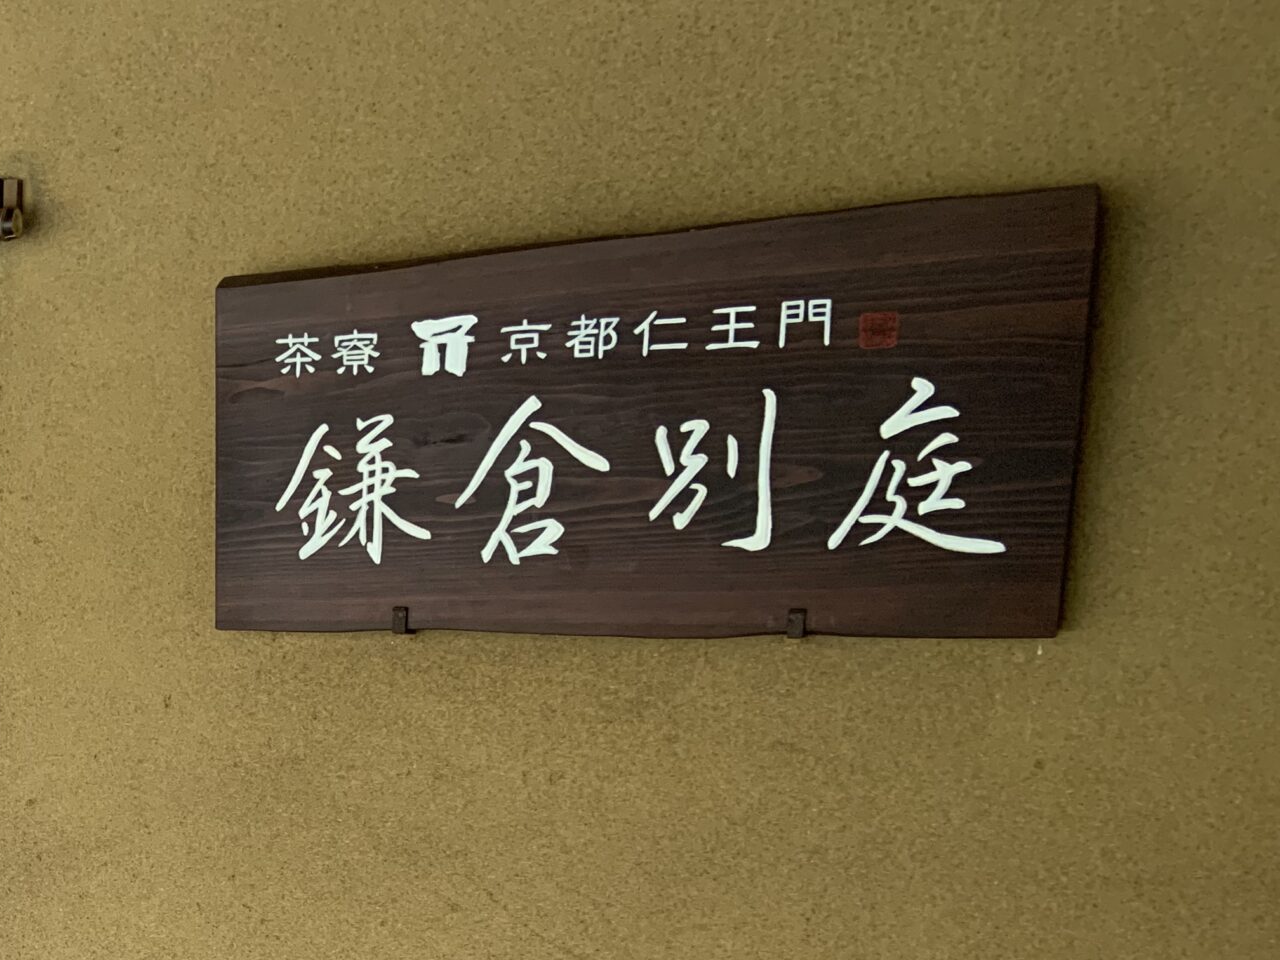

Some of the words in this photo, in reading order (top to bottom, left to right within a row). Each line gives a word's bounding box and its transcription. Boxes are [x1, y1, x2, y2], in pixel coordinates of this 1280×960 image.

[275, 331, 381, 378] 茶寮
[499, 298, 834, 366] 京都仁王門
[275, 376, 1008, 566] 鎌倉別庭
